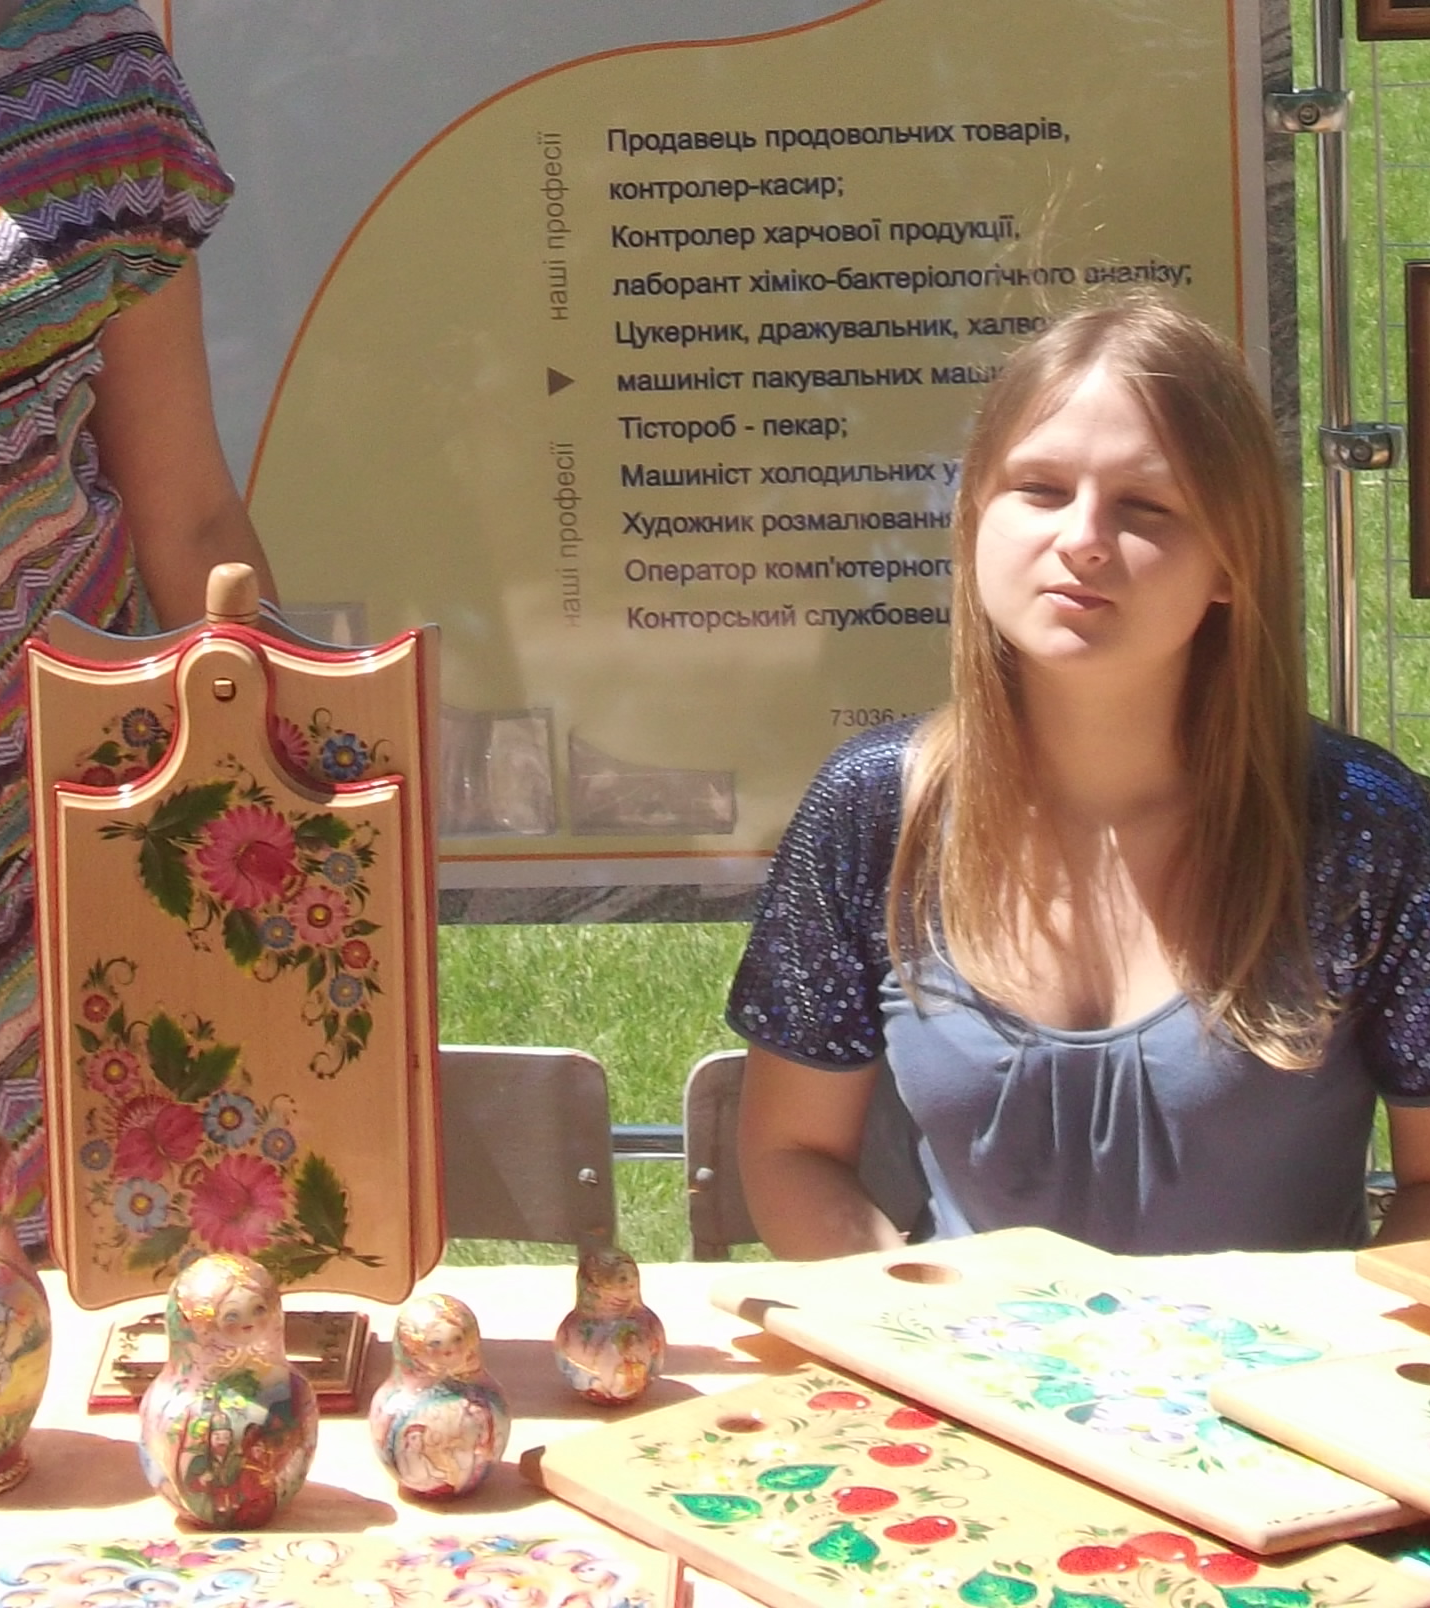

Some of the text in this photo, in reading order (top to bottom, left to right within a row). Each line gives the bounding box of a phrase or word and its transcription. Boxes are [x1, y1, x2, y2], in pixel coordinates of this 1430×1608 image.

[608, 117, 1069, 156] Продавець продовольчих товарів,
[610, 177, 843, 204] контролер-касир;
[538, 132, 571, 321] наші професії
[612, 225, 755, 251] Контролер
[763, 218, 881, 248] харчової
[613, 272, 741, 300] лаборант
[749, 265, 1075, 295] хіміко-бактеріологічного
[616, 313, 1054, 349] Цукерник, дражувальник, халво
[618, 367, 744, 391] машиніст
[753, 368, 923, 393] пакувальних
[618, 414, 736, 442] Тістороб
[763, 418, 847, 440] пекар;
[621, 463, 752, 487] Машиніст
[761, 464, 935, 486] холодильних
[550, 441, 583, 558] професії
[623, 512, 753, 539] Художник
[625, 559, 757, 587] Оператор
[628, 604, 795, 632] Конторський
[830, 709, 894, 728] 73036
